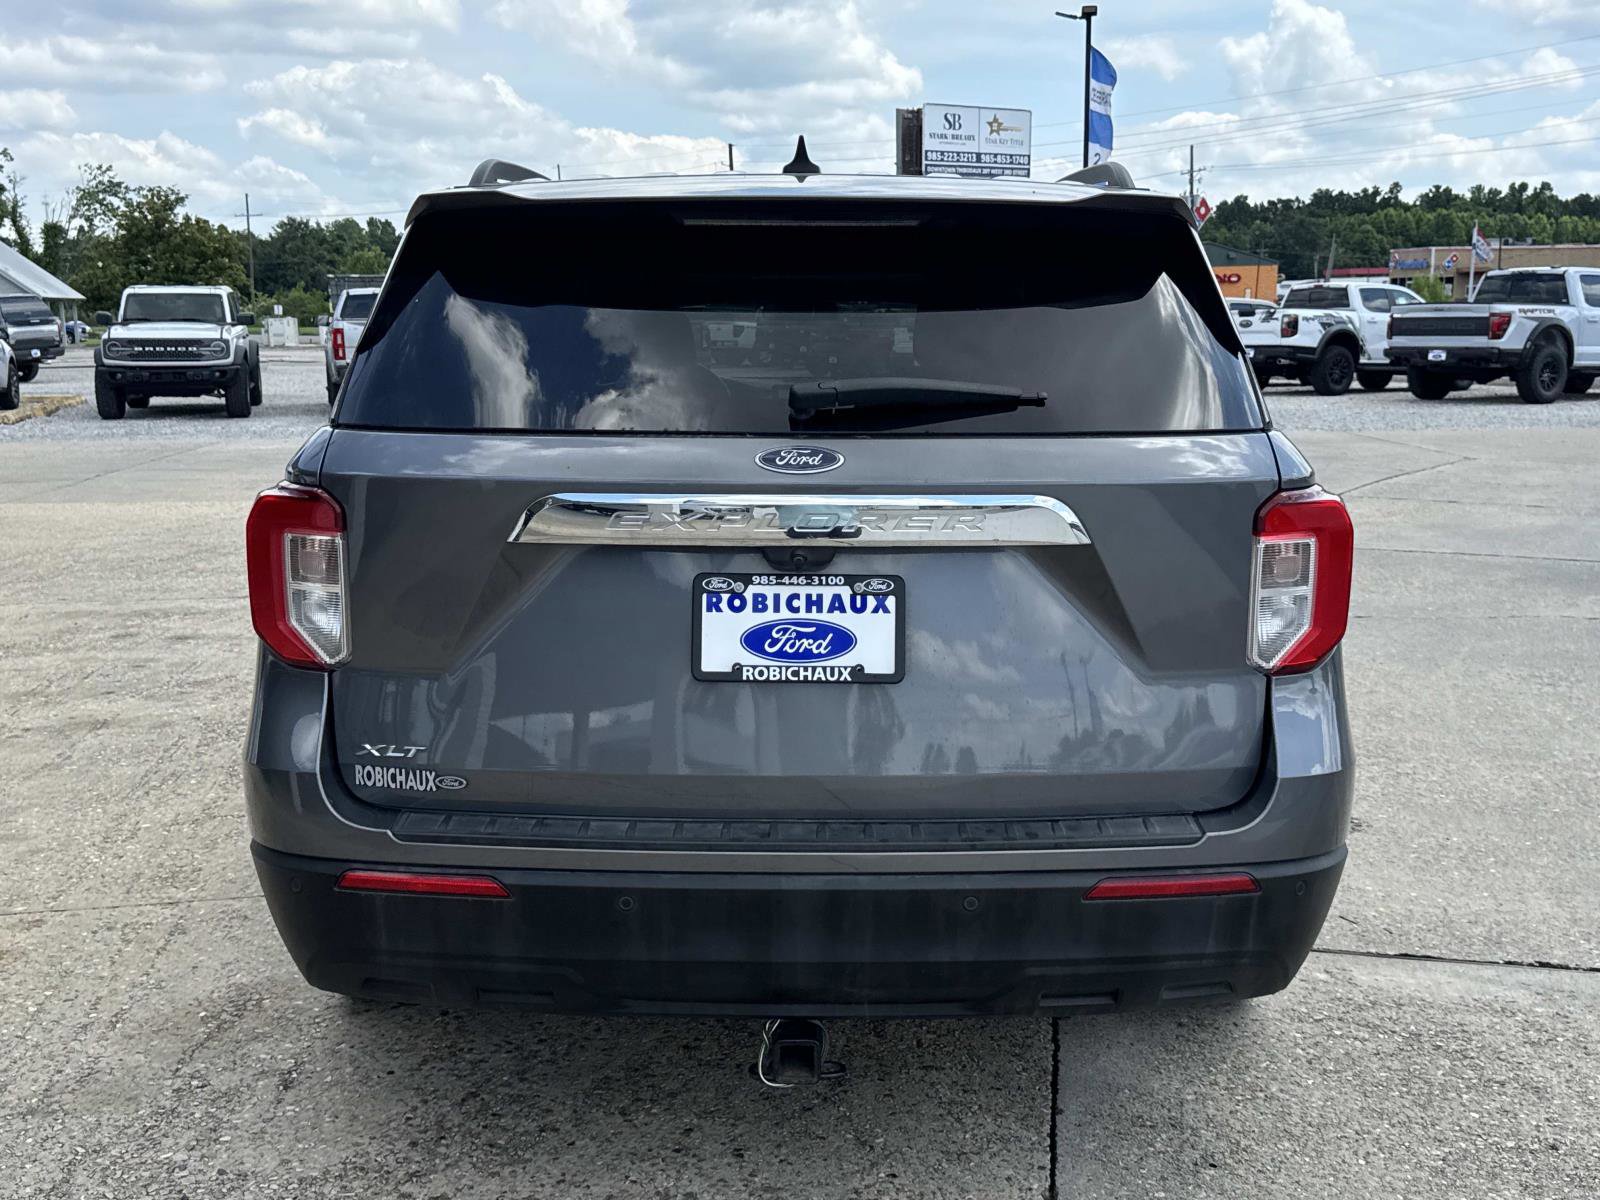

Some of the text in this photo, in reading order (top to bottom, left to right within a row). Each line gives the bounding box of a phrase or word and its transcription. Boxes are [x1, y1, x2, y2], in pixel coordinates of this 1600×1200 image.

[943, 112, 962, 131] SB
[928, 132, 948, 140] STARK
[926, 151, 977, 162] 985-223-3213
[775, 449, 824, 465] Ford
[605, 510, 987, 533] EXPLORER
[708, 579, 729, 590] Ford
[751, 575, 845, 586] 985-446-3100
[867, 580, 889, 591] Ford
[705, 592, 892, 615] ROBICHAUX
[763, 624, 833, 655] Ford
[741, 665, 852, 681] ROBICHAUX
[355, 743, 428, 758] XLT
[354, 764, 460, 792] ROBICHAUX Ford
